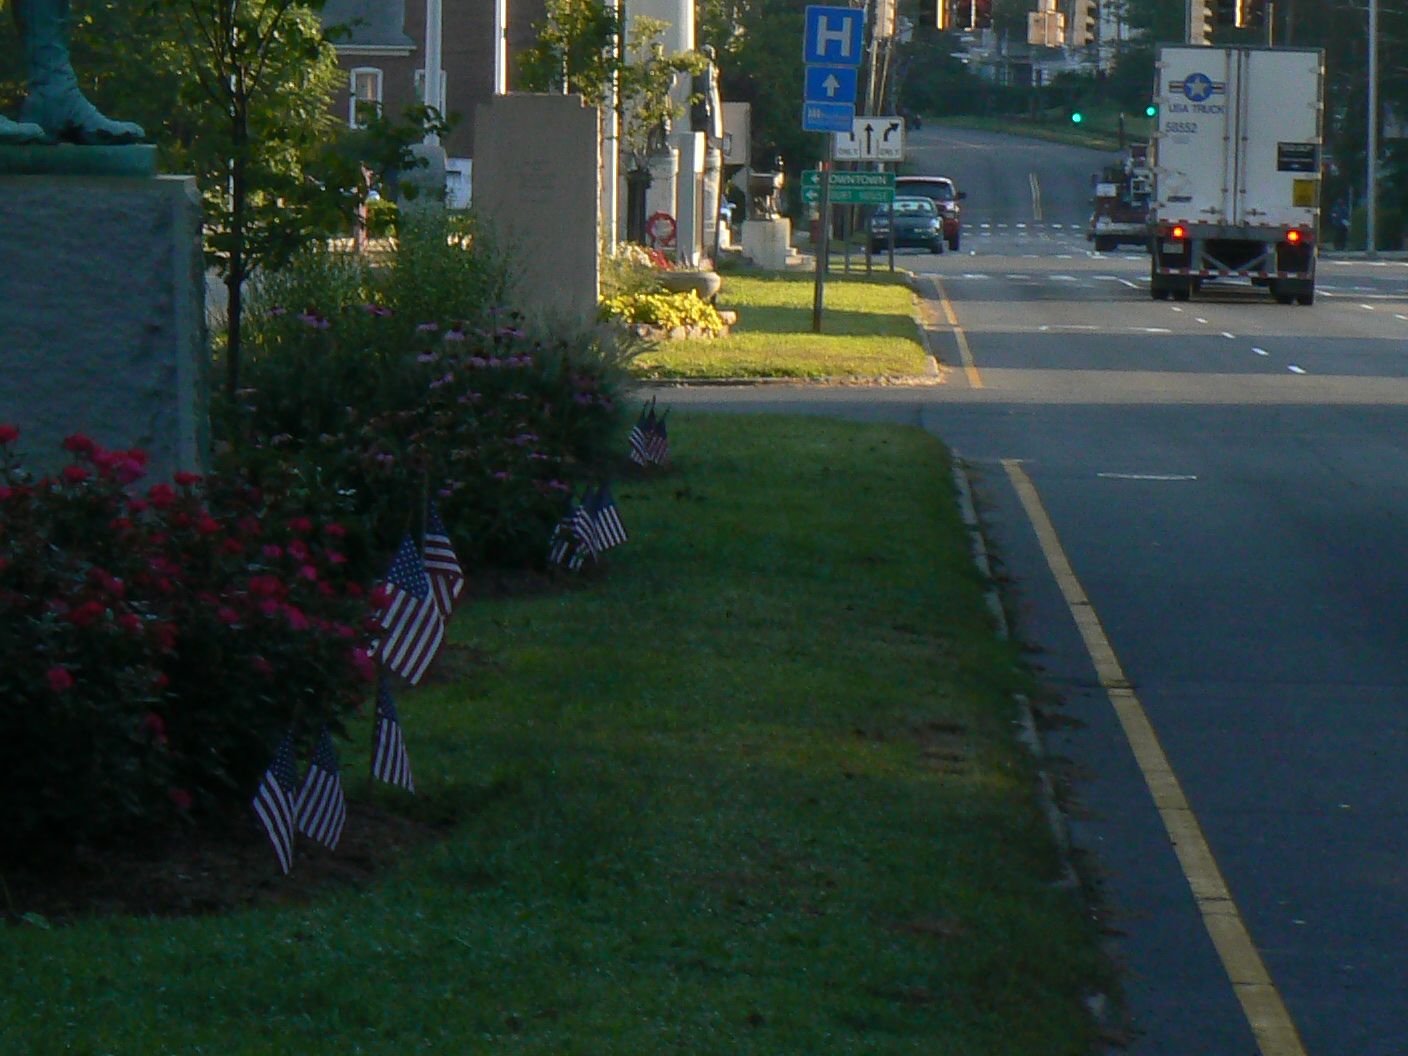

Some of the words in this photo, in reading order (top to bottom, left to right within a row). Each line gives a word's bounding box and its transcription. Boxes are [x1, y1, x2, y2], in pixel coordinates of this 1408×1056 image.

[816, 15, 852, 56] H
[1169, 104, 1189, 113] USA
[1193, 104, 1225, 114] TRUCK
[828, 174, 887, 185] OWNTOWN
